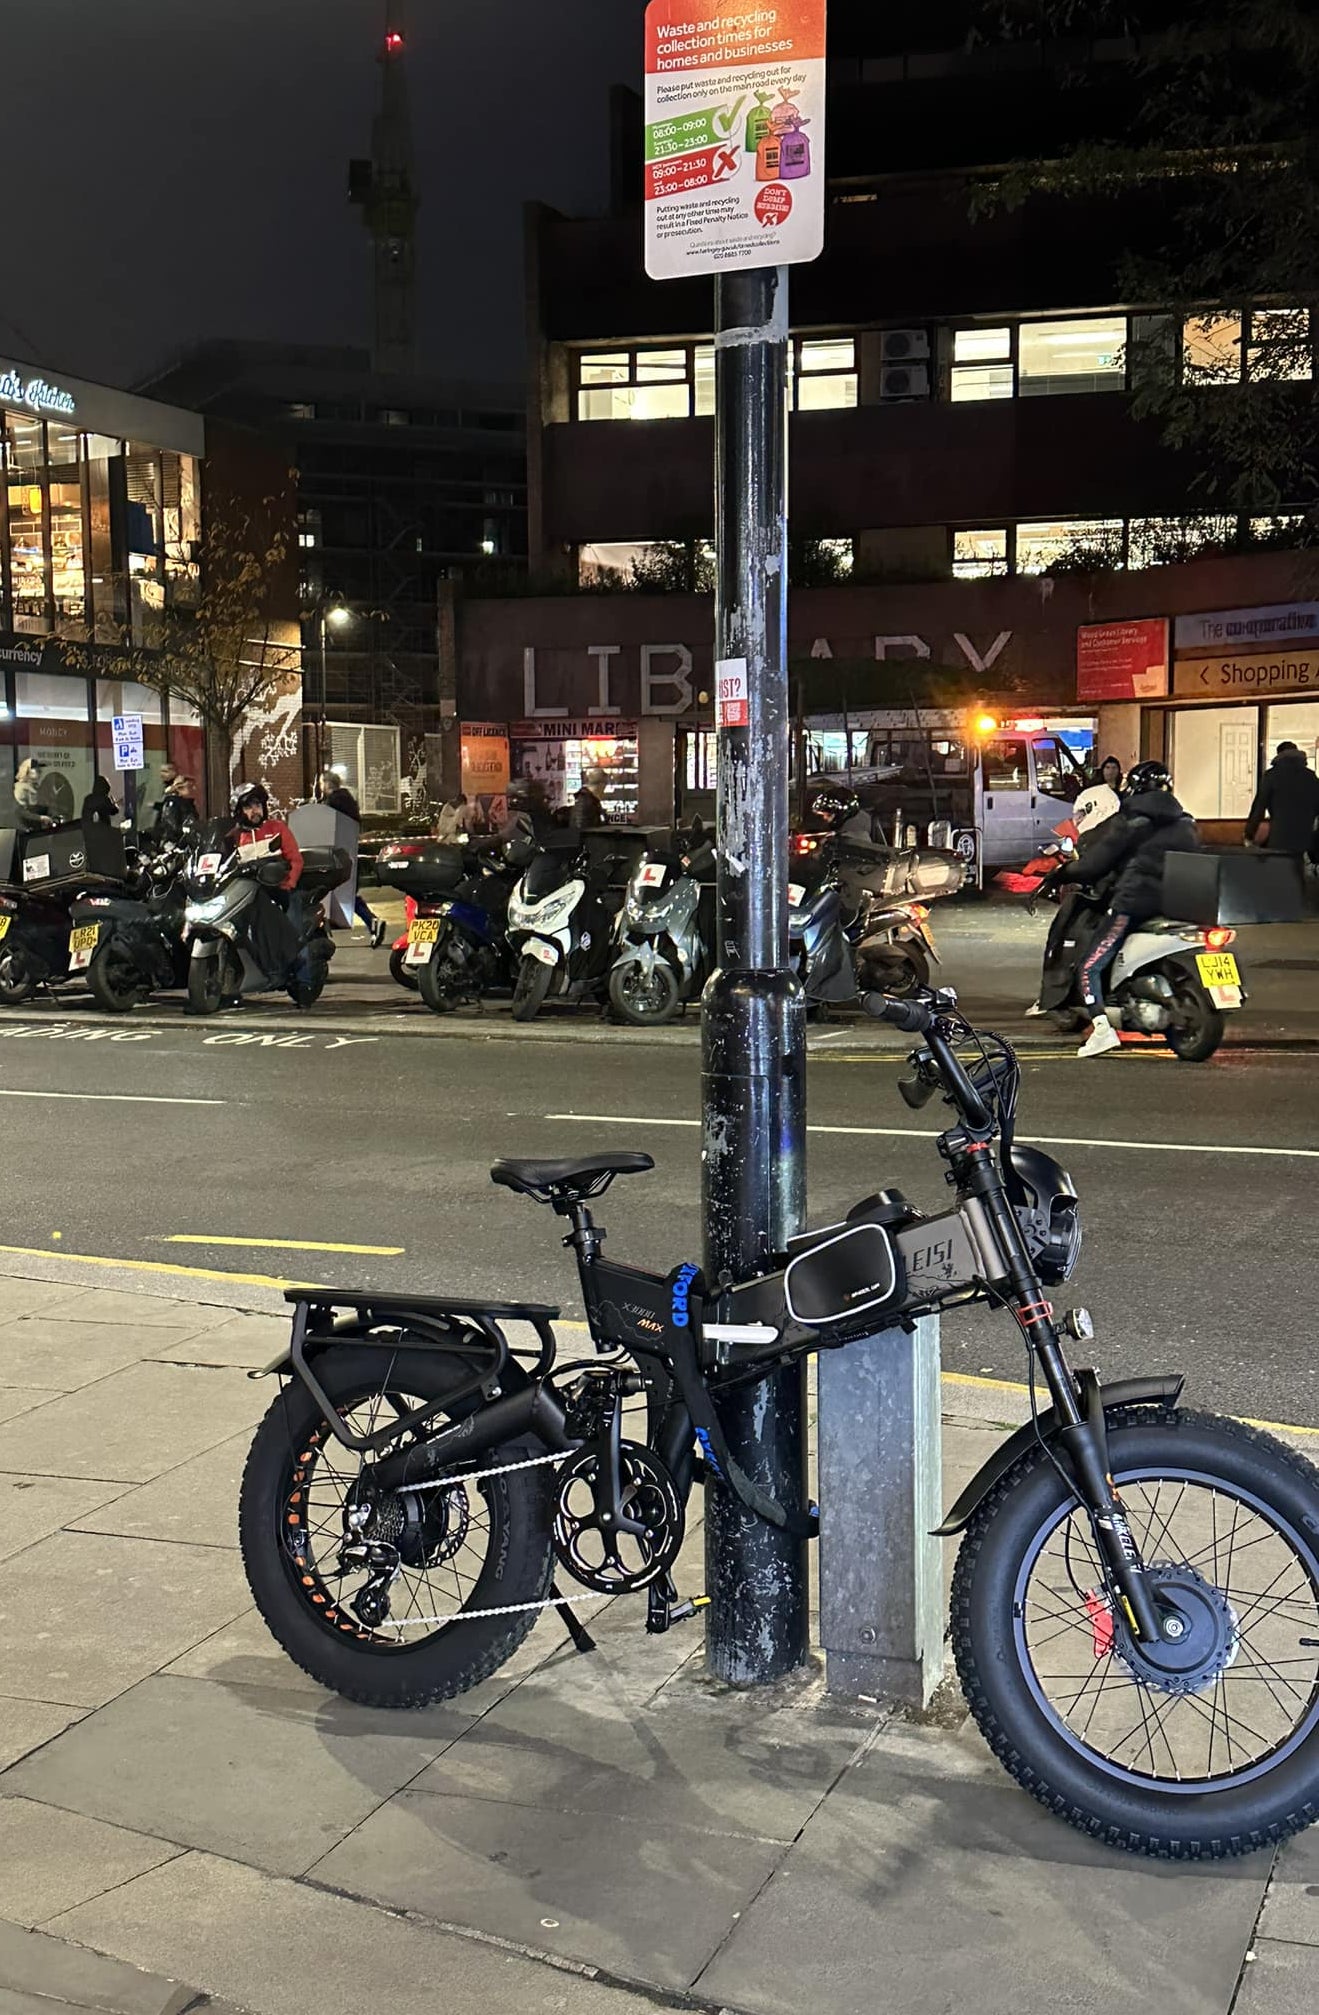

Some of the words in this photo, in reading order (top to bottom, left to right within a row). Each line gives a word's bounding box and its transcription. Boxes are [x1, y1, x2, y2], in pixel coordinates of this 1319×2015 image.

[657, 23, 695, 38] Waste
[697, 17, 719, 33] and
[721, 10, 777, 28] recycling
[657, 35, 715, 55] collection
[718, 30, 752, 44] times
[754, 25, 773, 38] for
[657, 54, 699, 70] homes
[700, 50, 722, 63] and
[725, 39, 793, 58] businesses
[657, 82, 680, 94] Please
[680, 81, 694, 93] put
[695, 79, 717, 88] waste
[717, 74, 731, 85] and
[732, 70, 766, 84] recycling
[766, 69, 779, 77] out
[780, 66, 792, 75] for
[657, 90, 692, 104] collection
[693, 88, 709, 99] only
[709, 87, 719, 95] on
[719, 85, 733, 94] the
[733, 82, 752, 91] main
[752, 79, 770, 89] road
[770, 76, 792, 87] every
[793, 73, 807, 83] day
[656, 204, 680, 214] Putting
[680, 201, 699, 209] waste
[699, 199, 711, 208] and
[711, 196, 740, 208] recycling
[656, 214, 667, 222] out
[667, 213, 675, 221] at
[675, 212, 686, 221] any
[687, 209, 705, 218] other
[705, 208, 720, 216] time
[720, 206, 734, 215] may
[656, 221, 674, 230] result
[686, 217, 703, 226] Fixed
[703, 214, 726, 225] Penalty
[727, 212, 748, 221] Notice
[1221, 660, 1310, 686] Shopping
[543, 722, 577, 736] MINI
[643, 868, 656, 881] L
[411, 921, 439, 930] PK20
[414, 931, 433, 941] VCA
[413, 941, 425, 957] L
[203, 1032, 380, 1049] ONLY
